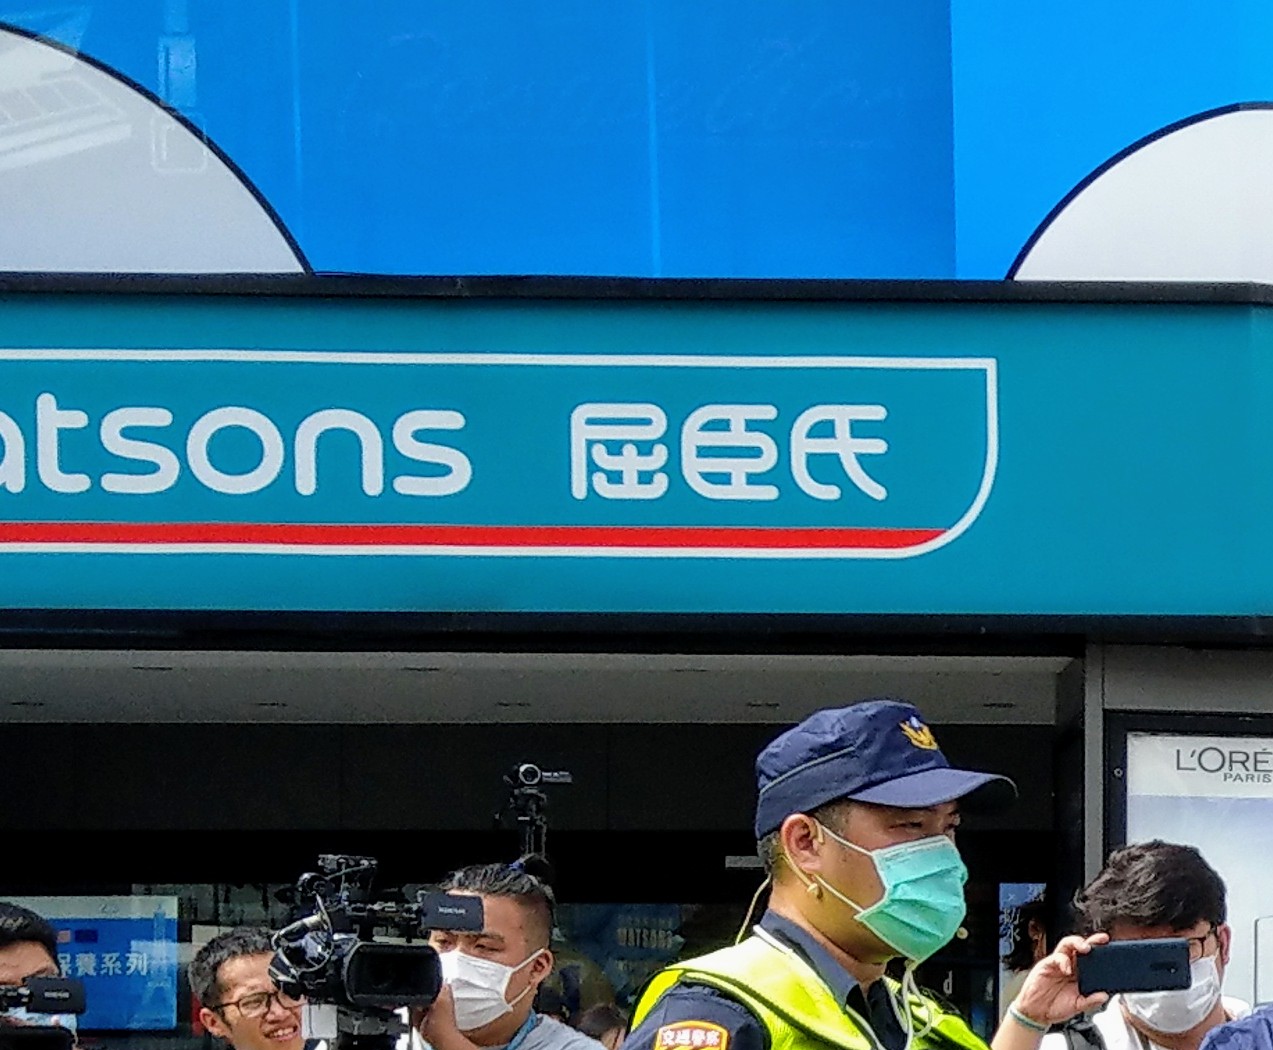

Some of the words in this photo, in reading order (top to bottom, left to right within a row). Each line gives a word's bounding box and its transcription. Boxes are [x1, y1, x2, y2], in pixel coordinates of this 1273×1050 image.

[571, 403, 888, 500] 屈臣氏
[1223, 772, 1272, 783] PARIS
